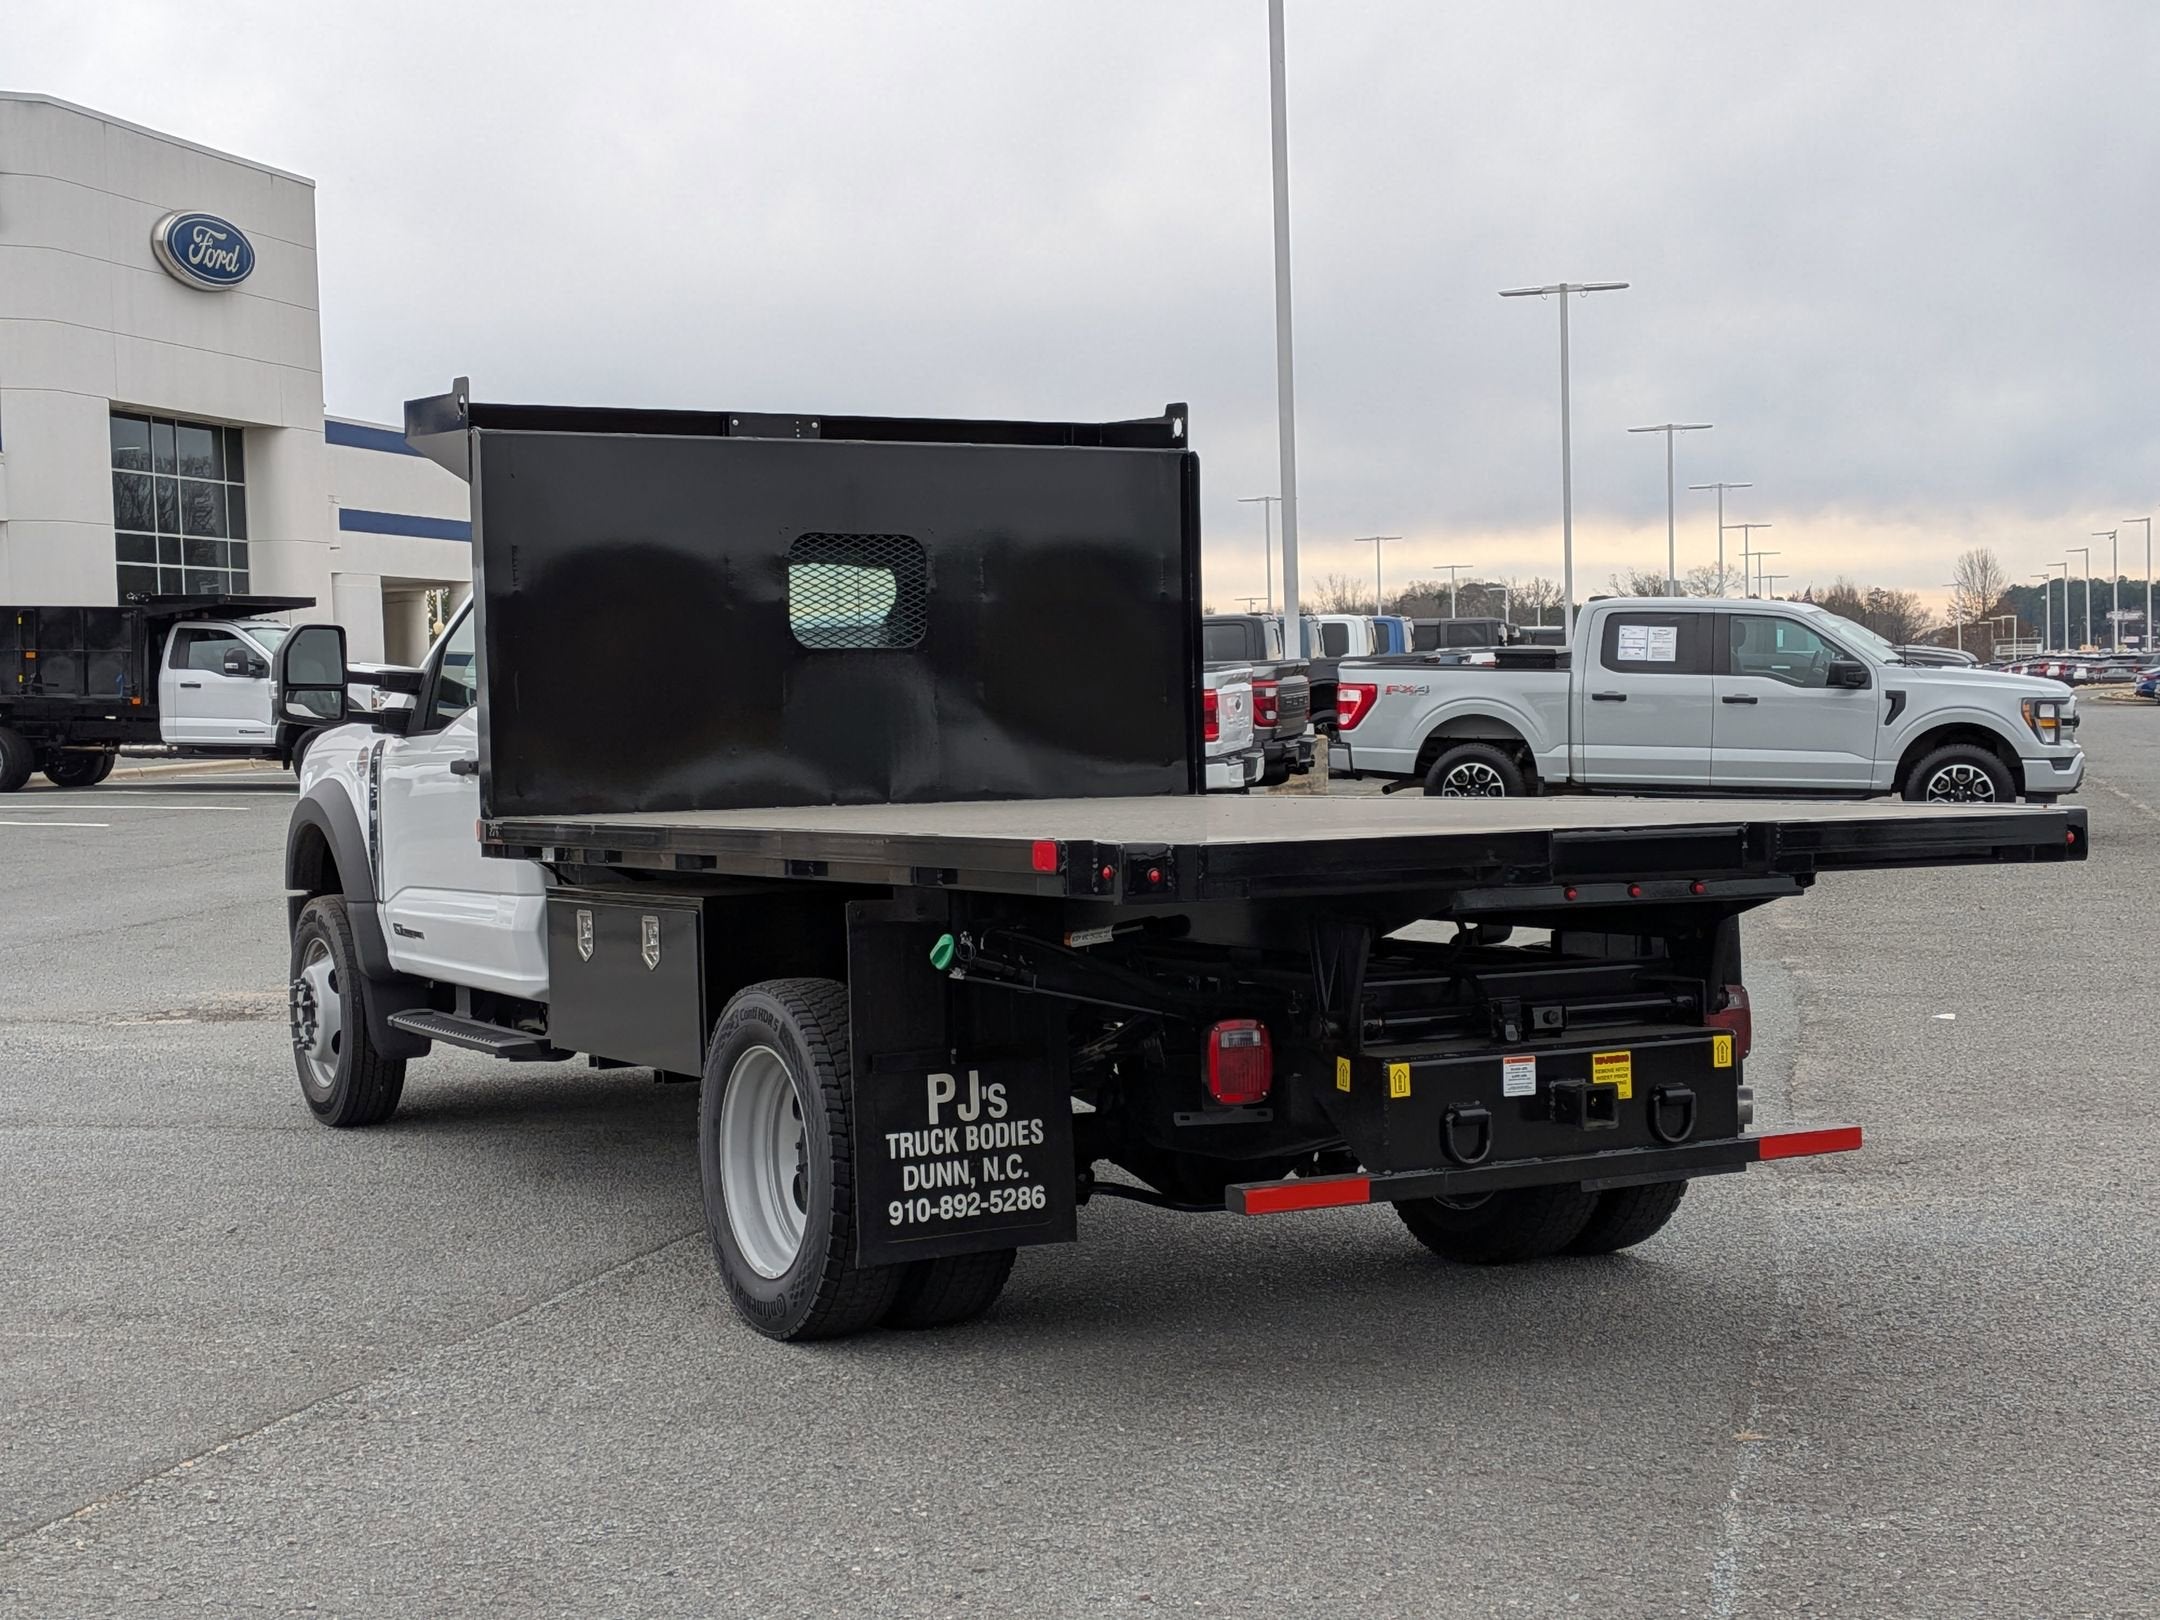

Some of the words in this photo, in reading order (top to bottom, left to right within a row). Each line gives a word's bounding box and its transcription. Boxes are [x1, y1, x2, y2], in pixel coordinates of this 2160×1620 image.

[188, 225, 240, 273] Ford
[1385, 685, 1430, 696] FX4
[885, 1127, 959, 1160] TRUCK
[965, 1118, 1044, 1151] BODIES
[903, 1159, 976, 1192] DUNN,
[983, 1153, 1029, 1183] N.C.
[888, 1185, 1046, 1226] 910-892-5286
